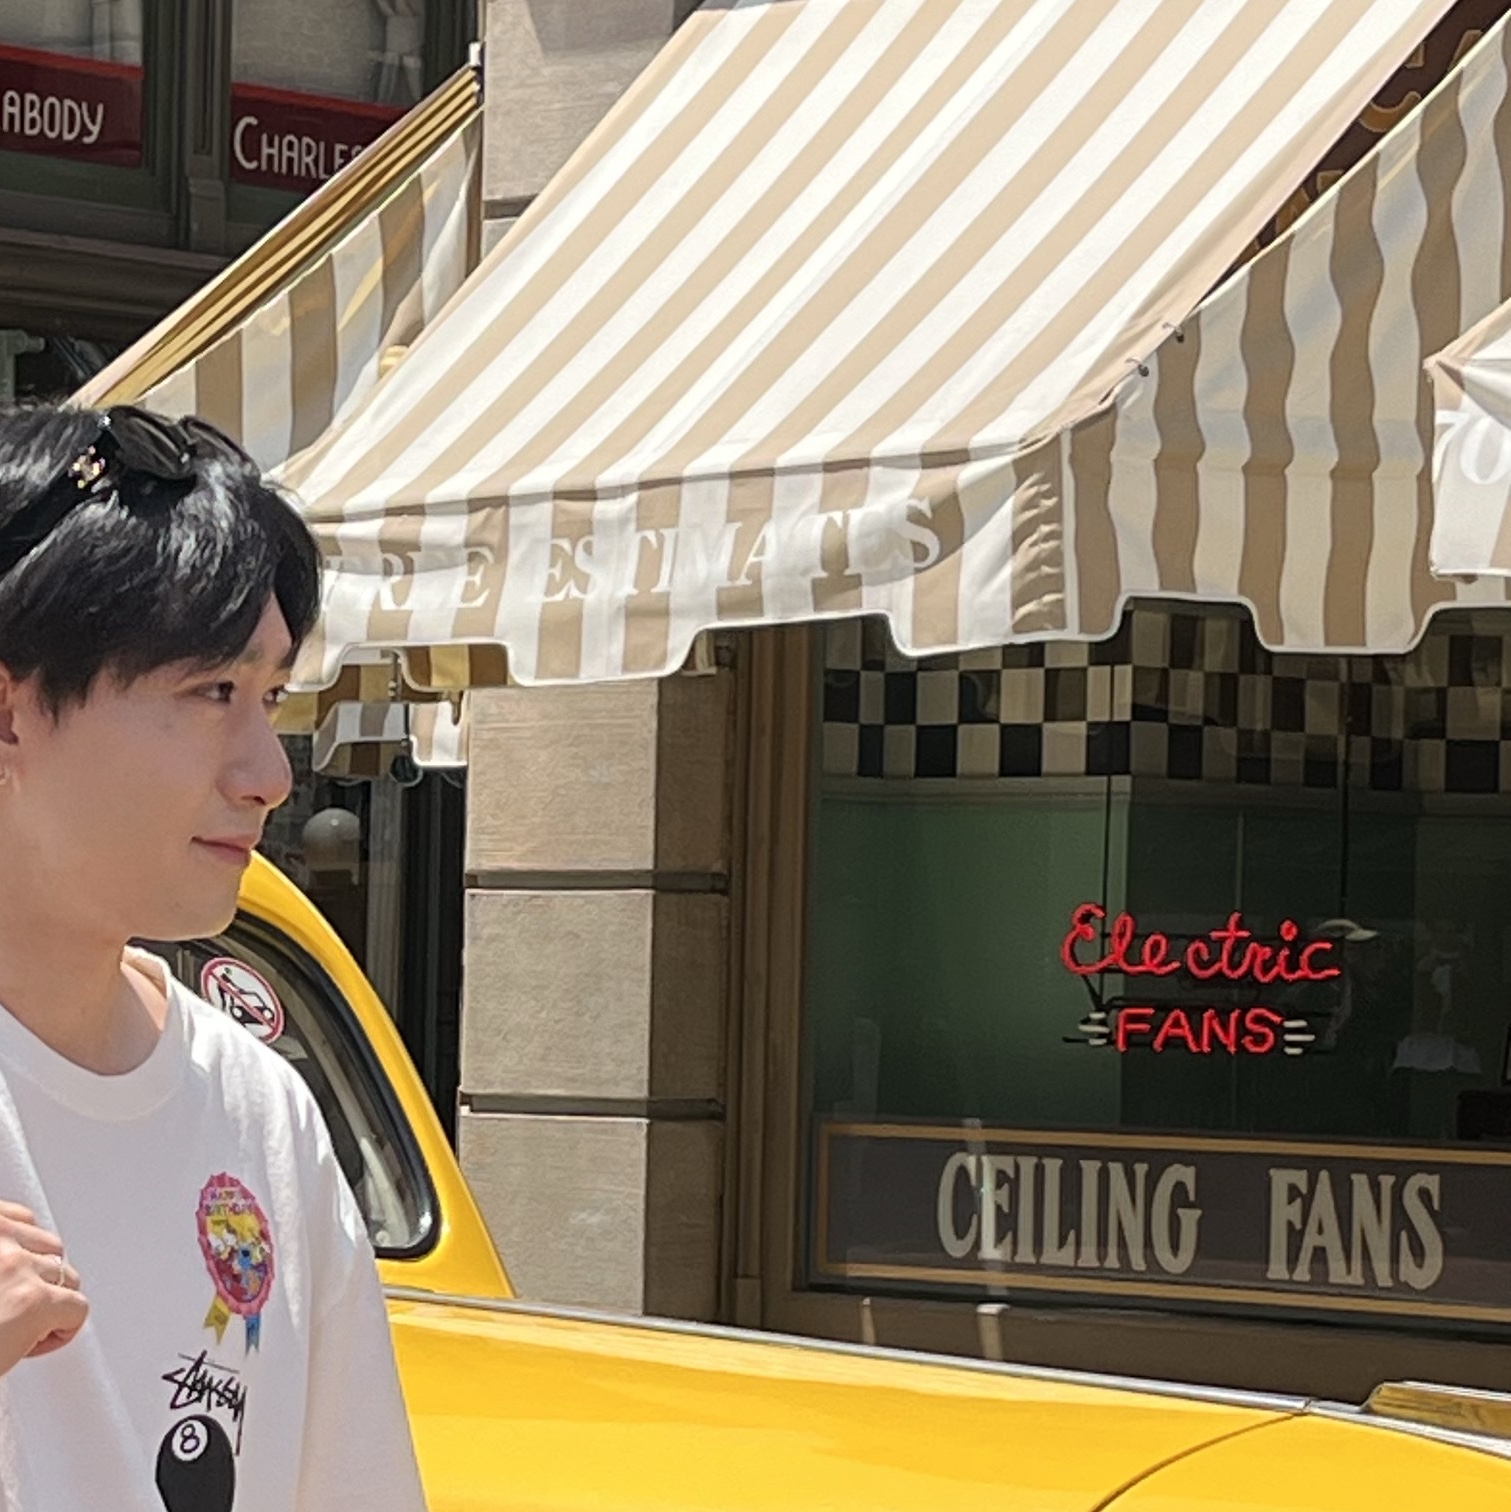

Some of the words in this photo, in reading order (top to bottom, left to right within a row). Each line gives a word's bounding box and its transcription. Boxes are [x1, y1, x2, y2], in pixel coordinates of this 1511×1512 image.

[233, 115, 368, 180] CHARLE
[536, 496, 941, 602] ESTIMATES
[1060, 902, 1341, 983] Electric
[1115, 1007, 1284, 1054] FANS
[936, 1151, 1202, 1274] CEILING
[1266, 1168, 1445, 1290] FANS
[180, 1423, 200, 1454] 8
